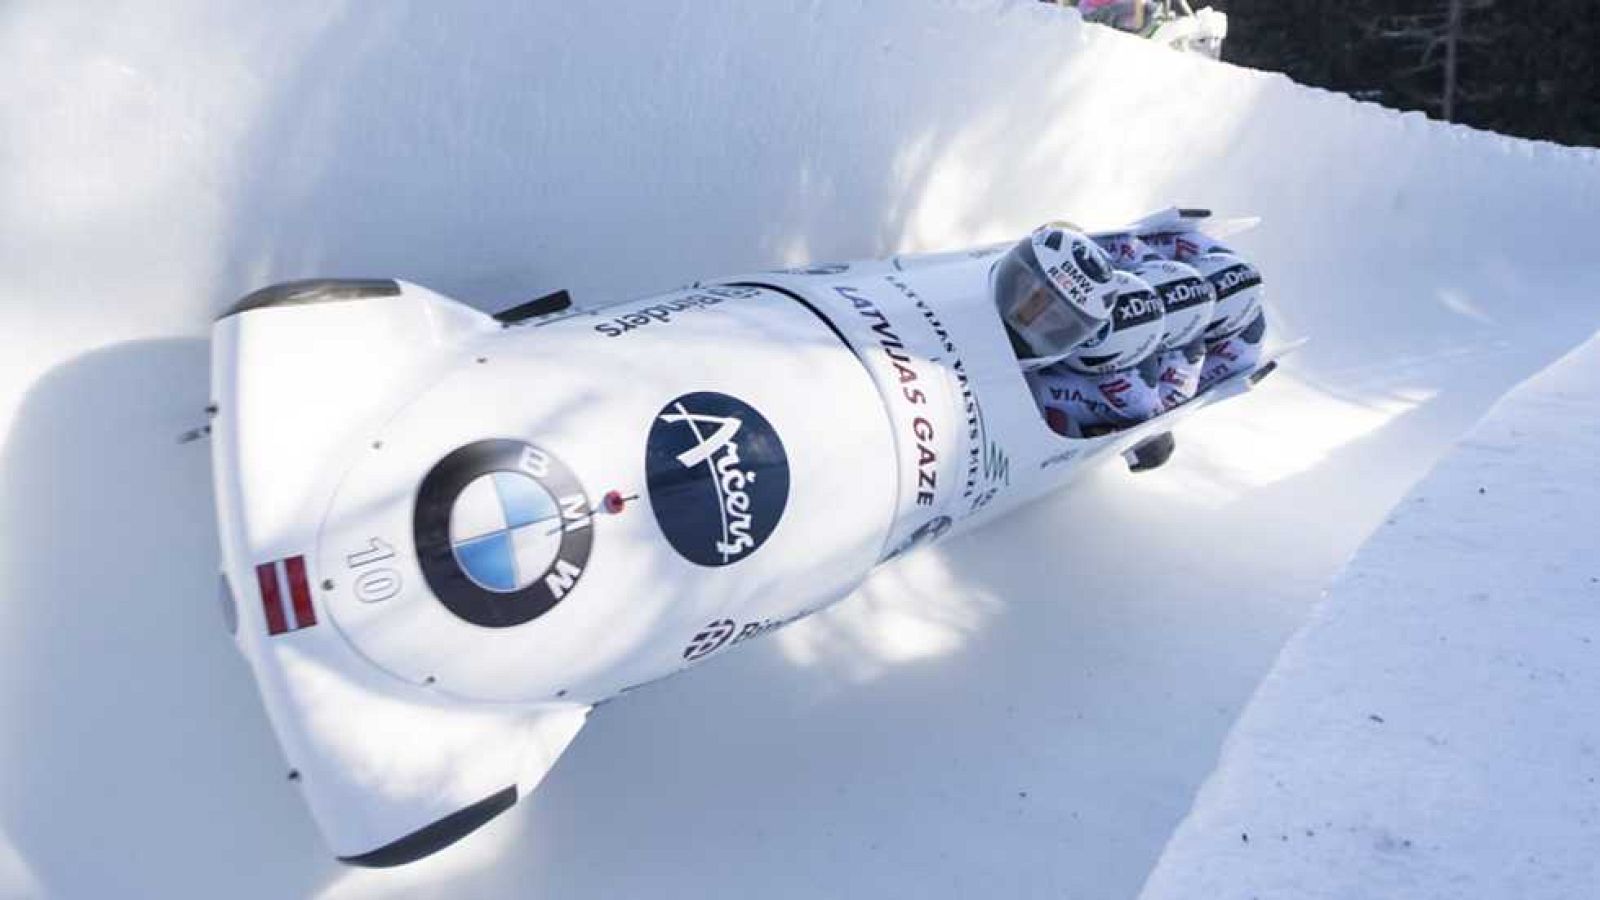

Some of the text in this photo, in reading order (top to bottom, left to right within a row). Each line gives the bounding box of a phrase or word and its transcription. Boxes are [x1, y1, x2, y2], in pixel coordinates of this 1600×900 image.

[1061, 261, 1094, 294] BMW
[594, 294, 724, 338] Binders
[833, 286, 937, 506] LATVIJAS GAZE
[518, 447, 590, 600] BMW
[346, 537, 401, 604] 10
